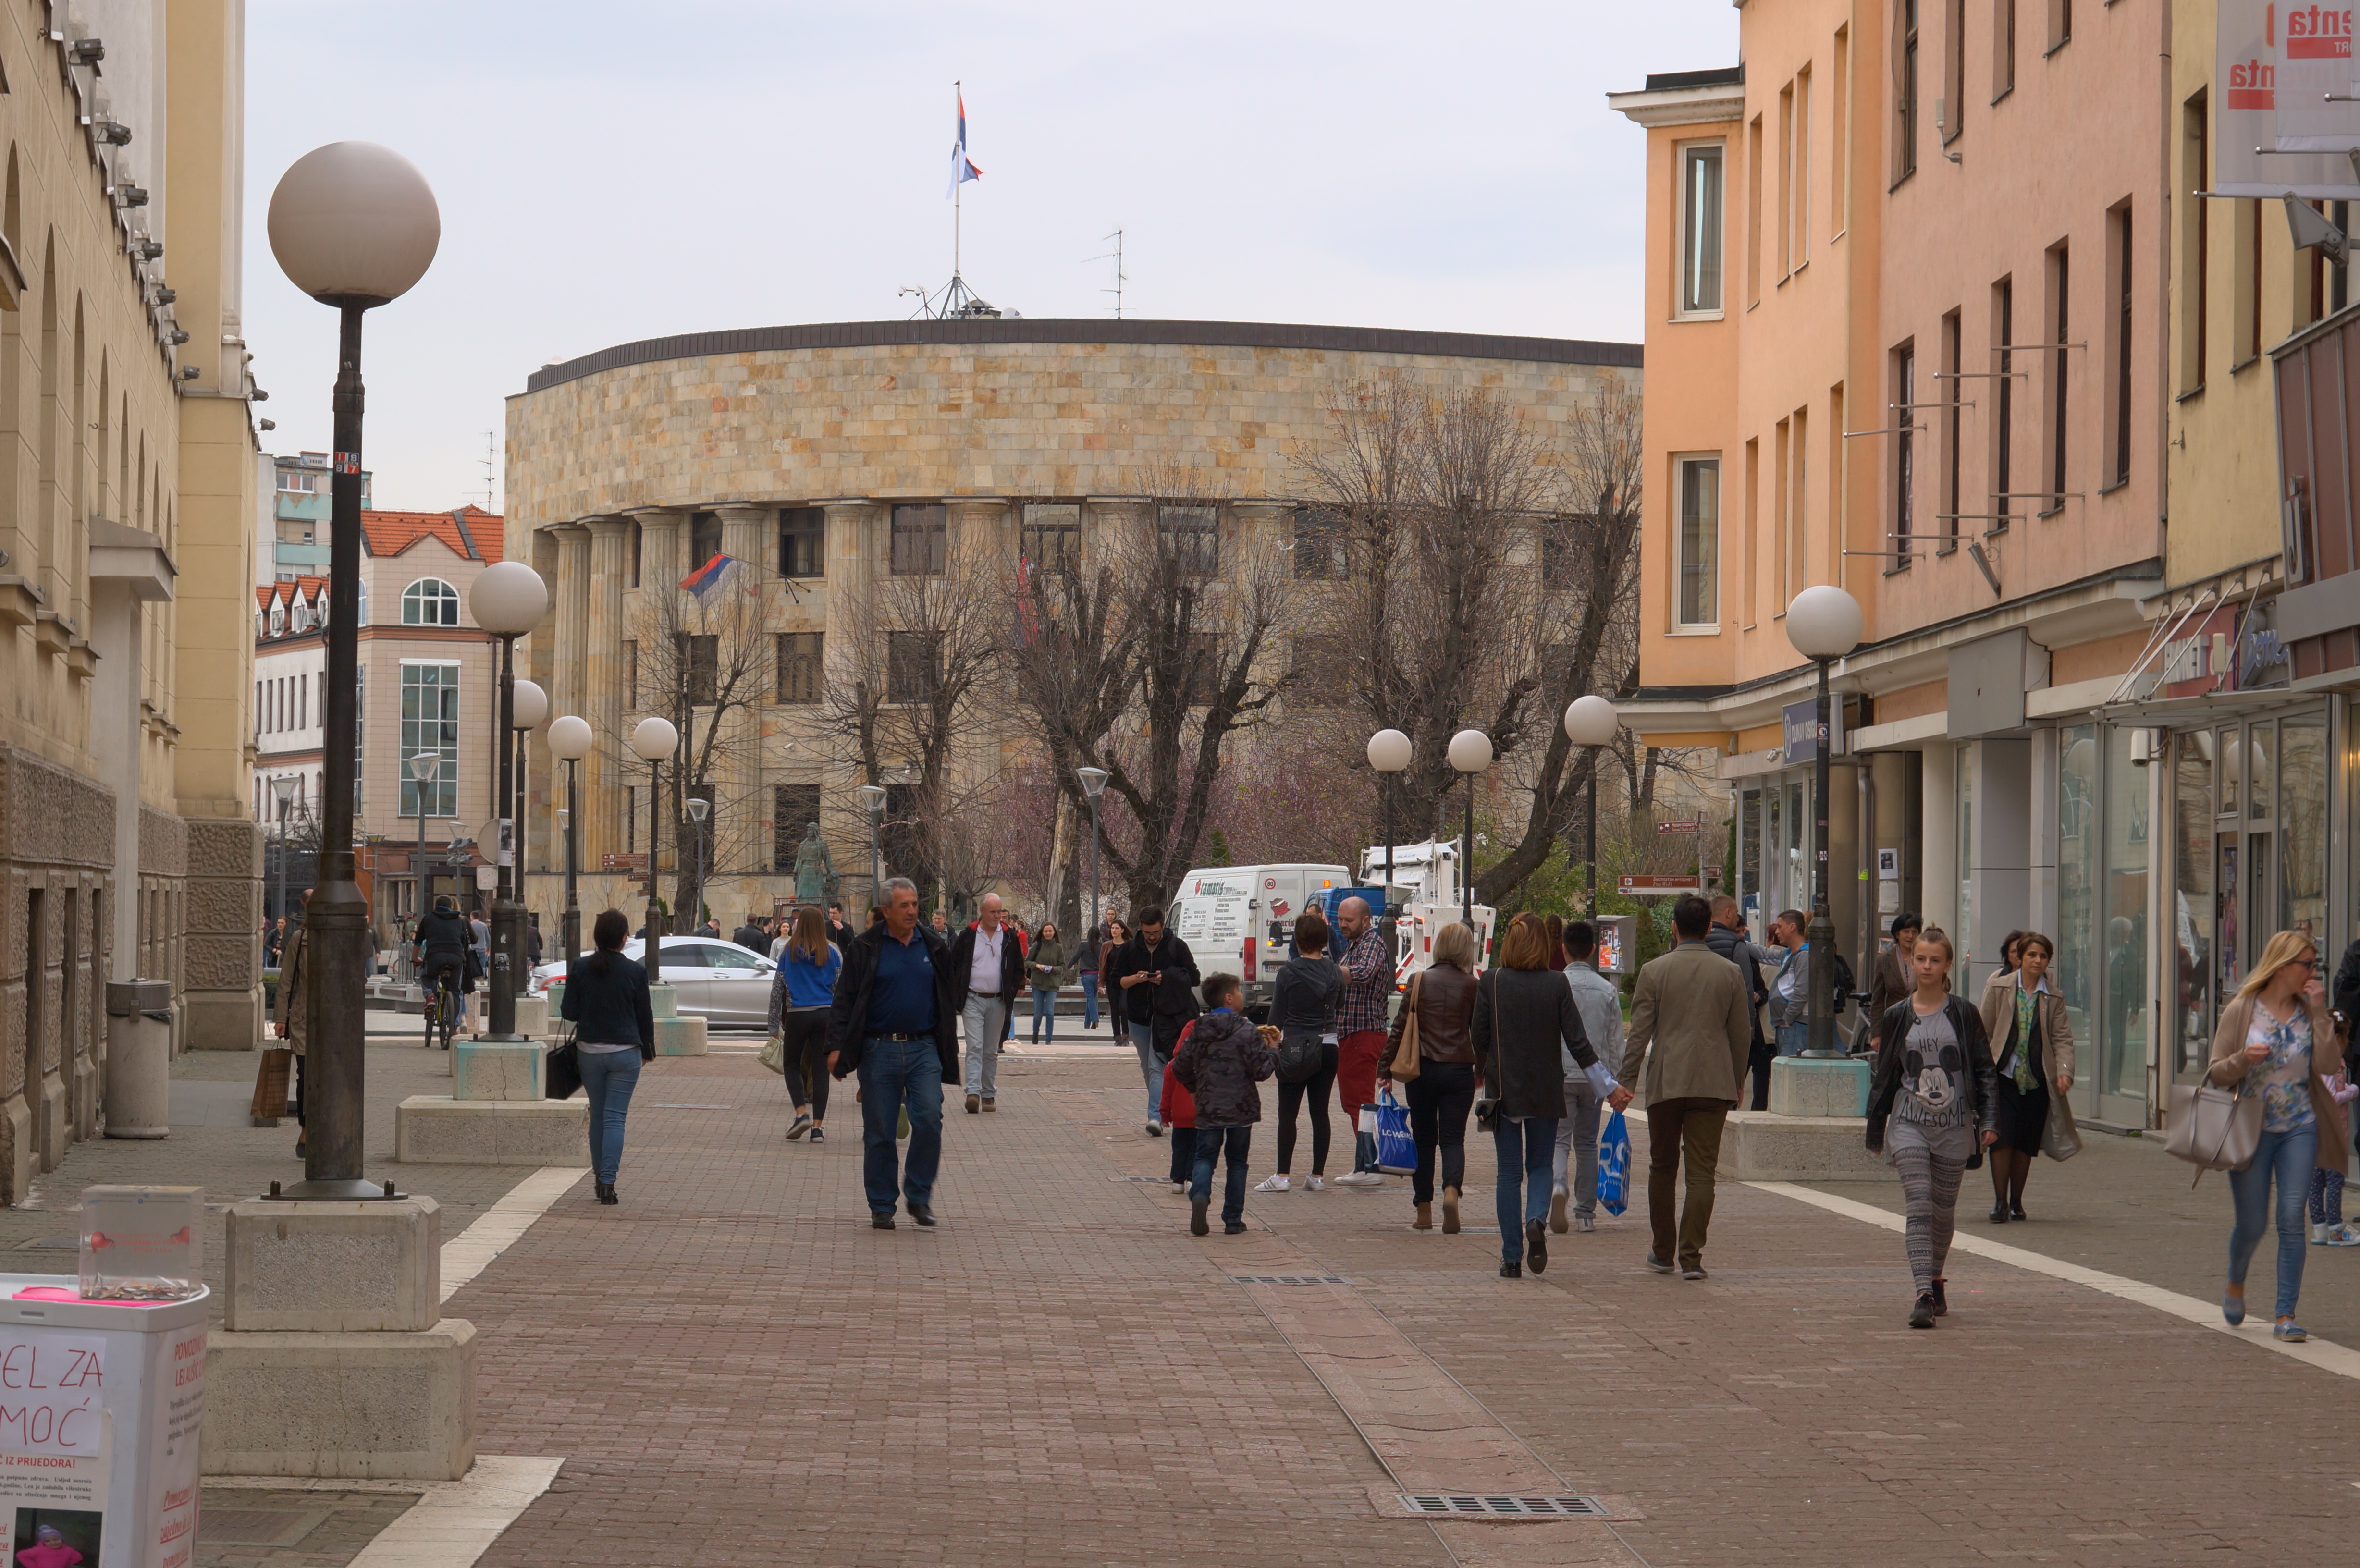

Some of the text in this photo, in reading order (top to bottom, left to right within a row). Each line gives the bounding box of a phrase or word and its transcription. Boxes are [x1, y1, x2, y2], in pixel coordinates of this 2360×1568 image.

[1919, 1037, 1939, 1053] HEY
[1898, 1095, 1967, 1128] AWESOME
[59, 1349, 103, 1388] ZA
[6, 1456, 14, 1465] IZ
[17, 1457, 76, 1469] PRIJEDORA!
